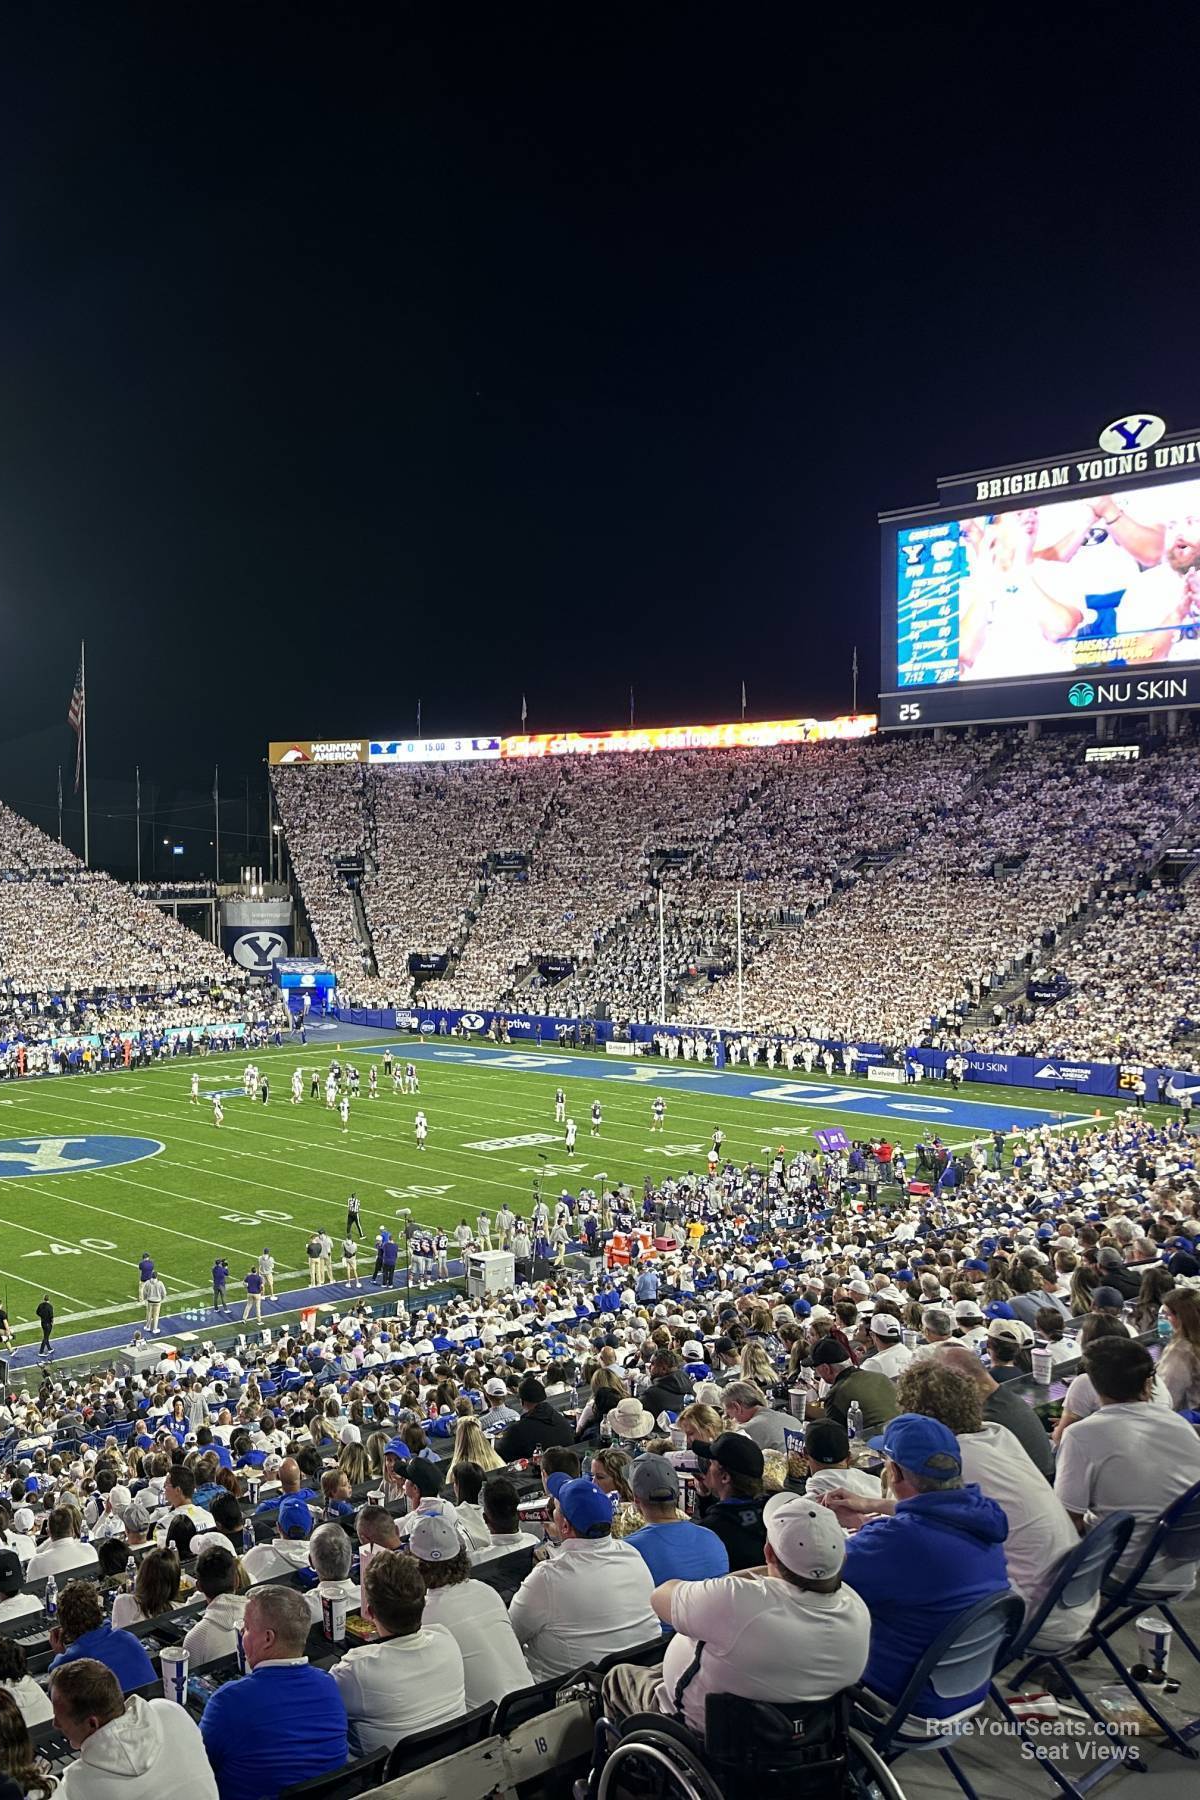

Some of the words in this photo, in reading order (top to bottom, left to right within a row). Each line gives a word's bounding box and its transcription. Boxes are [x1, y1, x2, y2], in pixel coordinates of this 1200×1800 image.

[976, 465, 1070, 501] BRIGHAM
[1076, 451, 1148, 482] YOUNG
[1098, 683, 1131, 703] NU
[1137, 679, 1187, 700] SKIN
[900, 704, 920, 721] 25
[310, 743, 362, 753] MOUNTAIN
[408, 743, 414, 752] 0
[455, 742, 461, 750] 3
[551, 738, 599, 755] savory
[313, 752, 359, 761] AMERICA
[507, 1018, 531, 1030] ptive
[971, 1062, 985, 1070] NU
[986, 1063, 1008, 1073] SKIN
[1059, 1066, 1091, 1075] MOUNTAIN
[1061, 1072, 1089, 1080] AMERICA
[579, 1201, 591, 1211] 78
[219, 1209, 294, 1227] 50
[621, 1214, 633, 1226] 55
[47, 1238, 118, 1257] 40
[535, 1737, 548, 1755] 18
